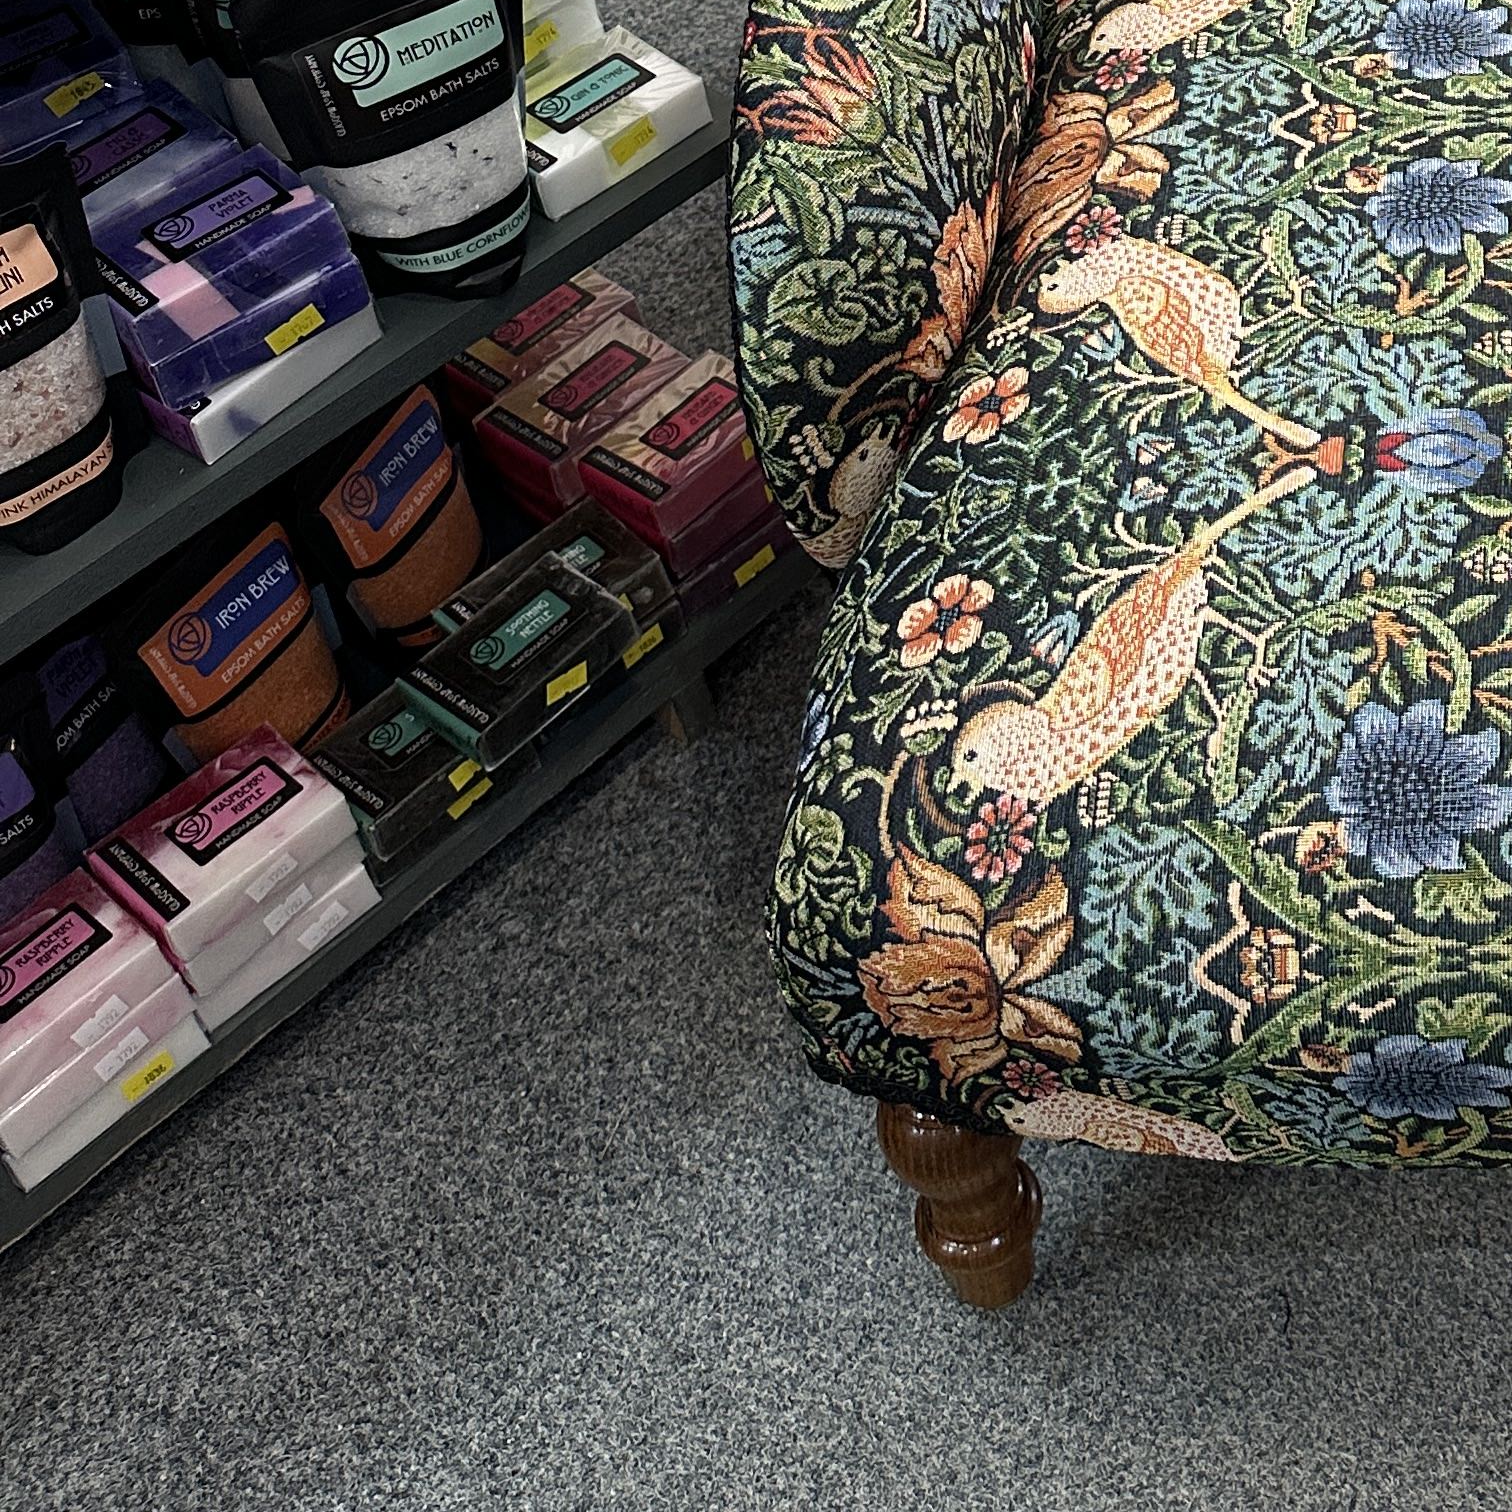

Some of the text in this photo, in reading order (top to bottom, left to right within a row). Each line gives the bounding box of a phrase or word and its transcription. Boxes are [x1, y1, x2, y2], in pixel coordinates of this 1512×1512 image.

[396, 11, 495, 66] MEDITATION
[380, 57, 500, 122] EPSOM BATH SALTS
[570, 87, 591, 102] GIN
[599, 65, 630, 85] TONIC
[575, 81, 638, 122] HANDMADE SOAP
[93, 138, 167, 185] HANDMADE SOAP
[208, 189, 249, 212] PARMA
[215, 196, 255, 219] VIOLET
[194, 203, 273, 249] HANDMADE SOAP
[395, 255, 430, 267] WITH
[433, 248, 465, 266] BLUE
[12, 296, 55, 327] SALTS
[379, 415, 439, 487] IRON BREW
[30, 450, 107, 506] HIMALAYAN
[389, 505, 416, 538] EPSOM
[412, 478, 436, 507] BATH
[215, 555, 291, 630] IRON BREW
[504, 599, 550, 637] SOOTHING
[519, 610, 555, 639] NETTLE
[221, 595, 306, 684] EPSOM BATH SALTS
[510, 617, 569, 668] HANDMADE SOAP
[73, 699, 101, 729] BATH
[439, 685, 460, 704] SOAP
[460, 698, 490, 724] GLASGOW
[211, 770, 267, 816] RASPBERRY
[230, 787, 267, 816] RIPPLE
[0, 814, 34, 845] SALTS
[215, 795, 283, 850] HANDMADE SOAP
[134, 869, 155, 888] SOAP
[154, 884, 181, 912] GLASGOW
[15, 918, 76, 968] RASPBERRY
[35, 936, 74, 968] RIPPLE
[17, 943, 91, 1004] HANDMADE SOAP
